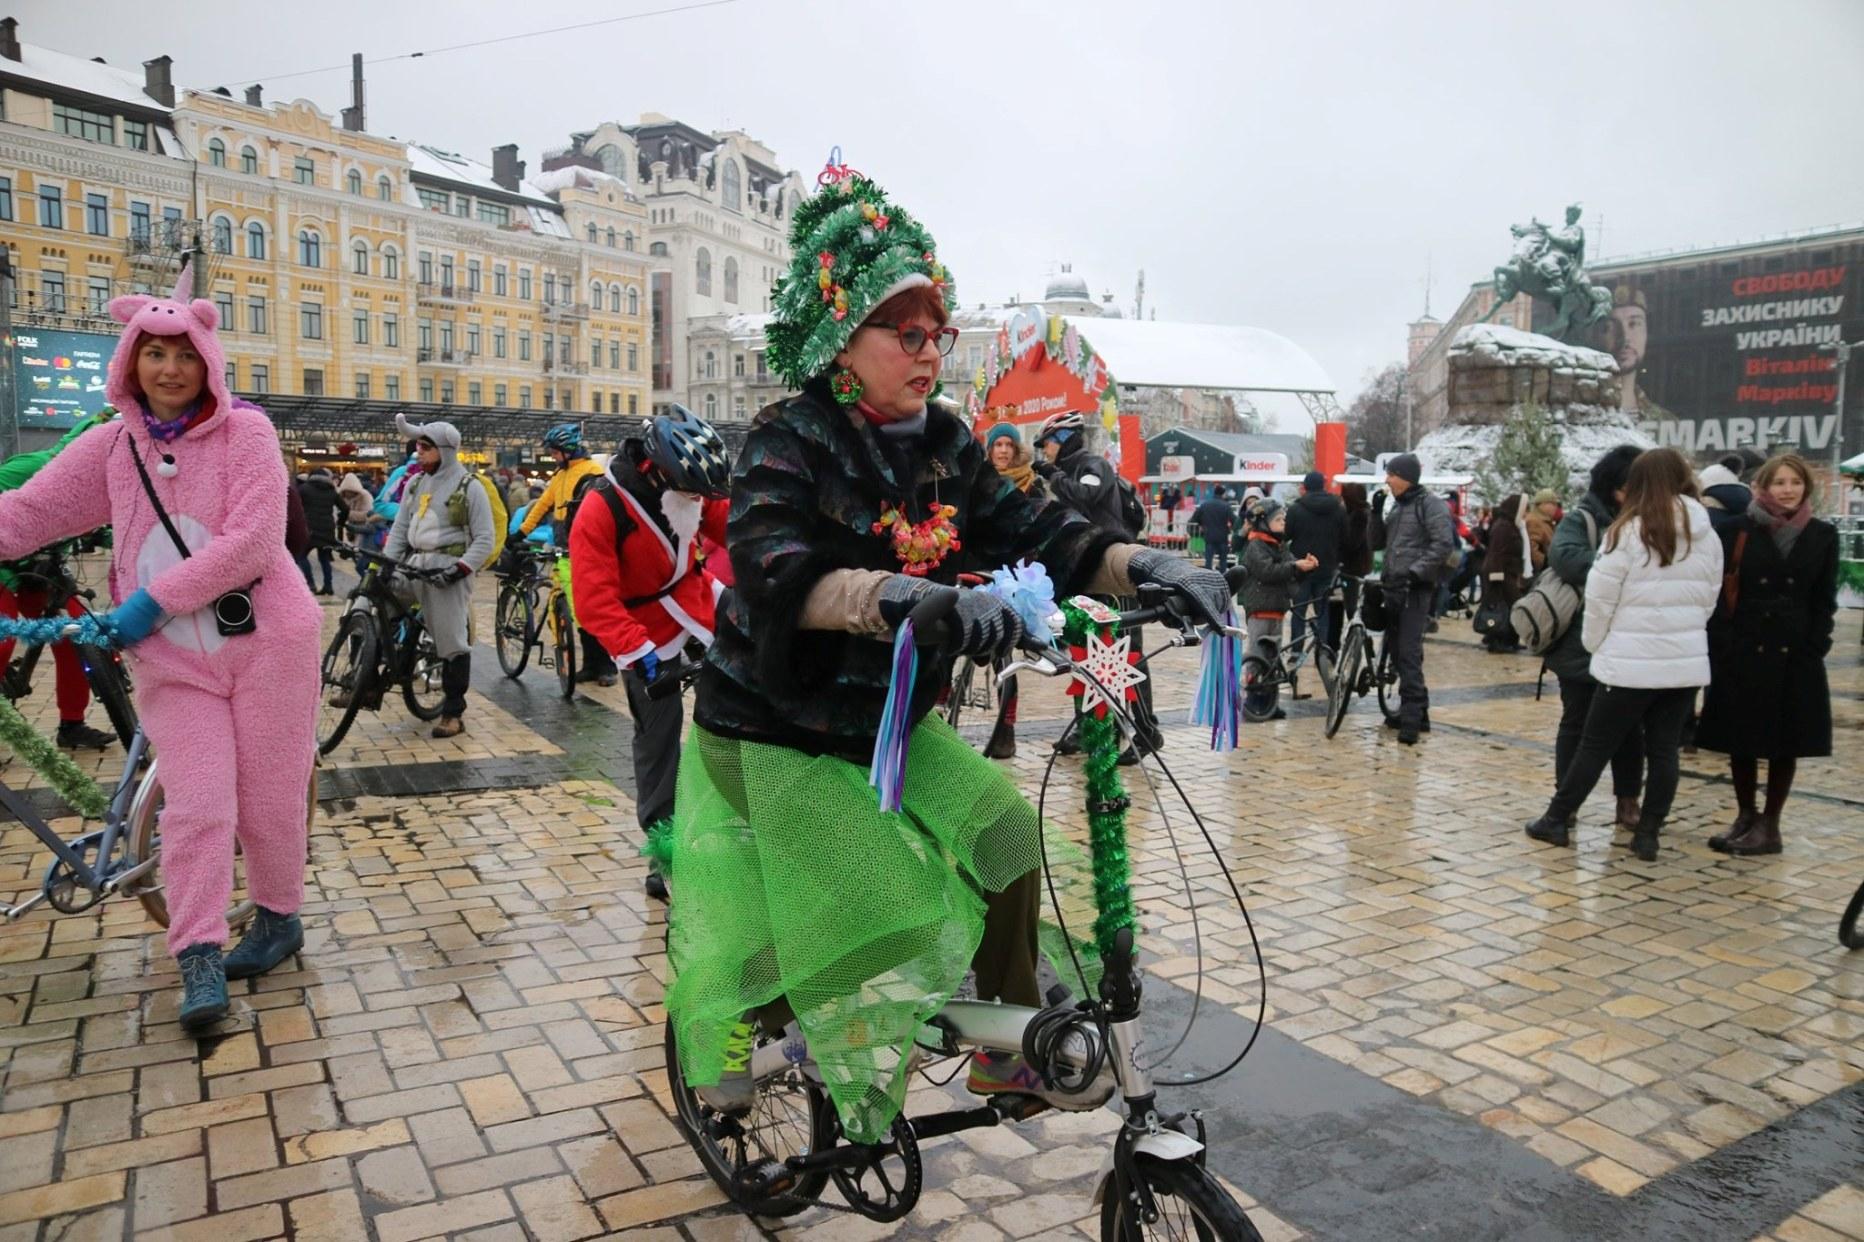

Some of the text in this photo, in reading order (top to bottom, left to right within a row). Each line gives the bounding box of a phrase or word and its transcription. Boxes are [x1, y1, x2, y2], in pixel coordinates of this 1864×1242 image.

[1732, 267, 1846, 296] СВОБОДУ
[1702, 295, 1845, 327] ЗАХИСНИКУ
[1736, 322, 1842, 350] УКРАЇНИ
[1239, 459, 1277, 471] kinder
